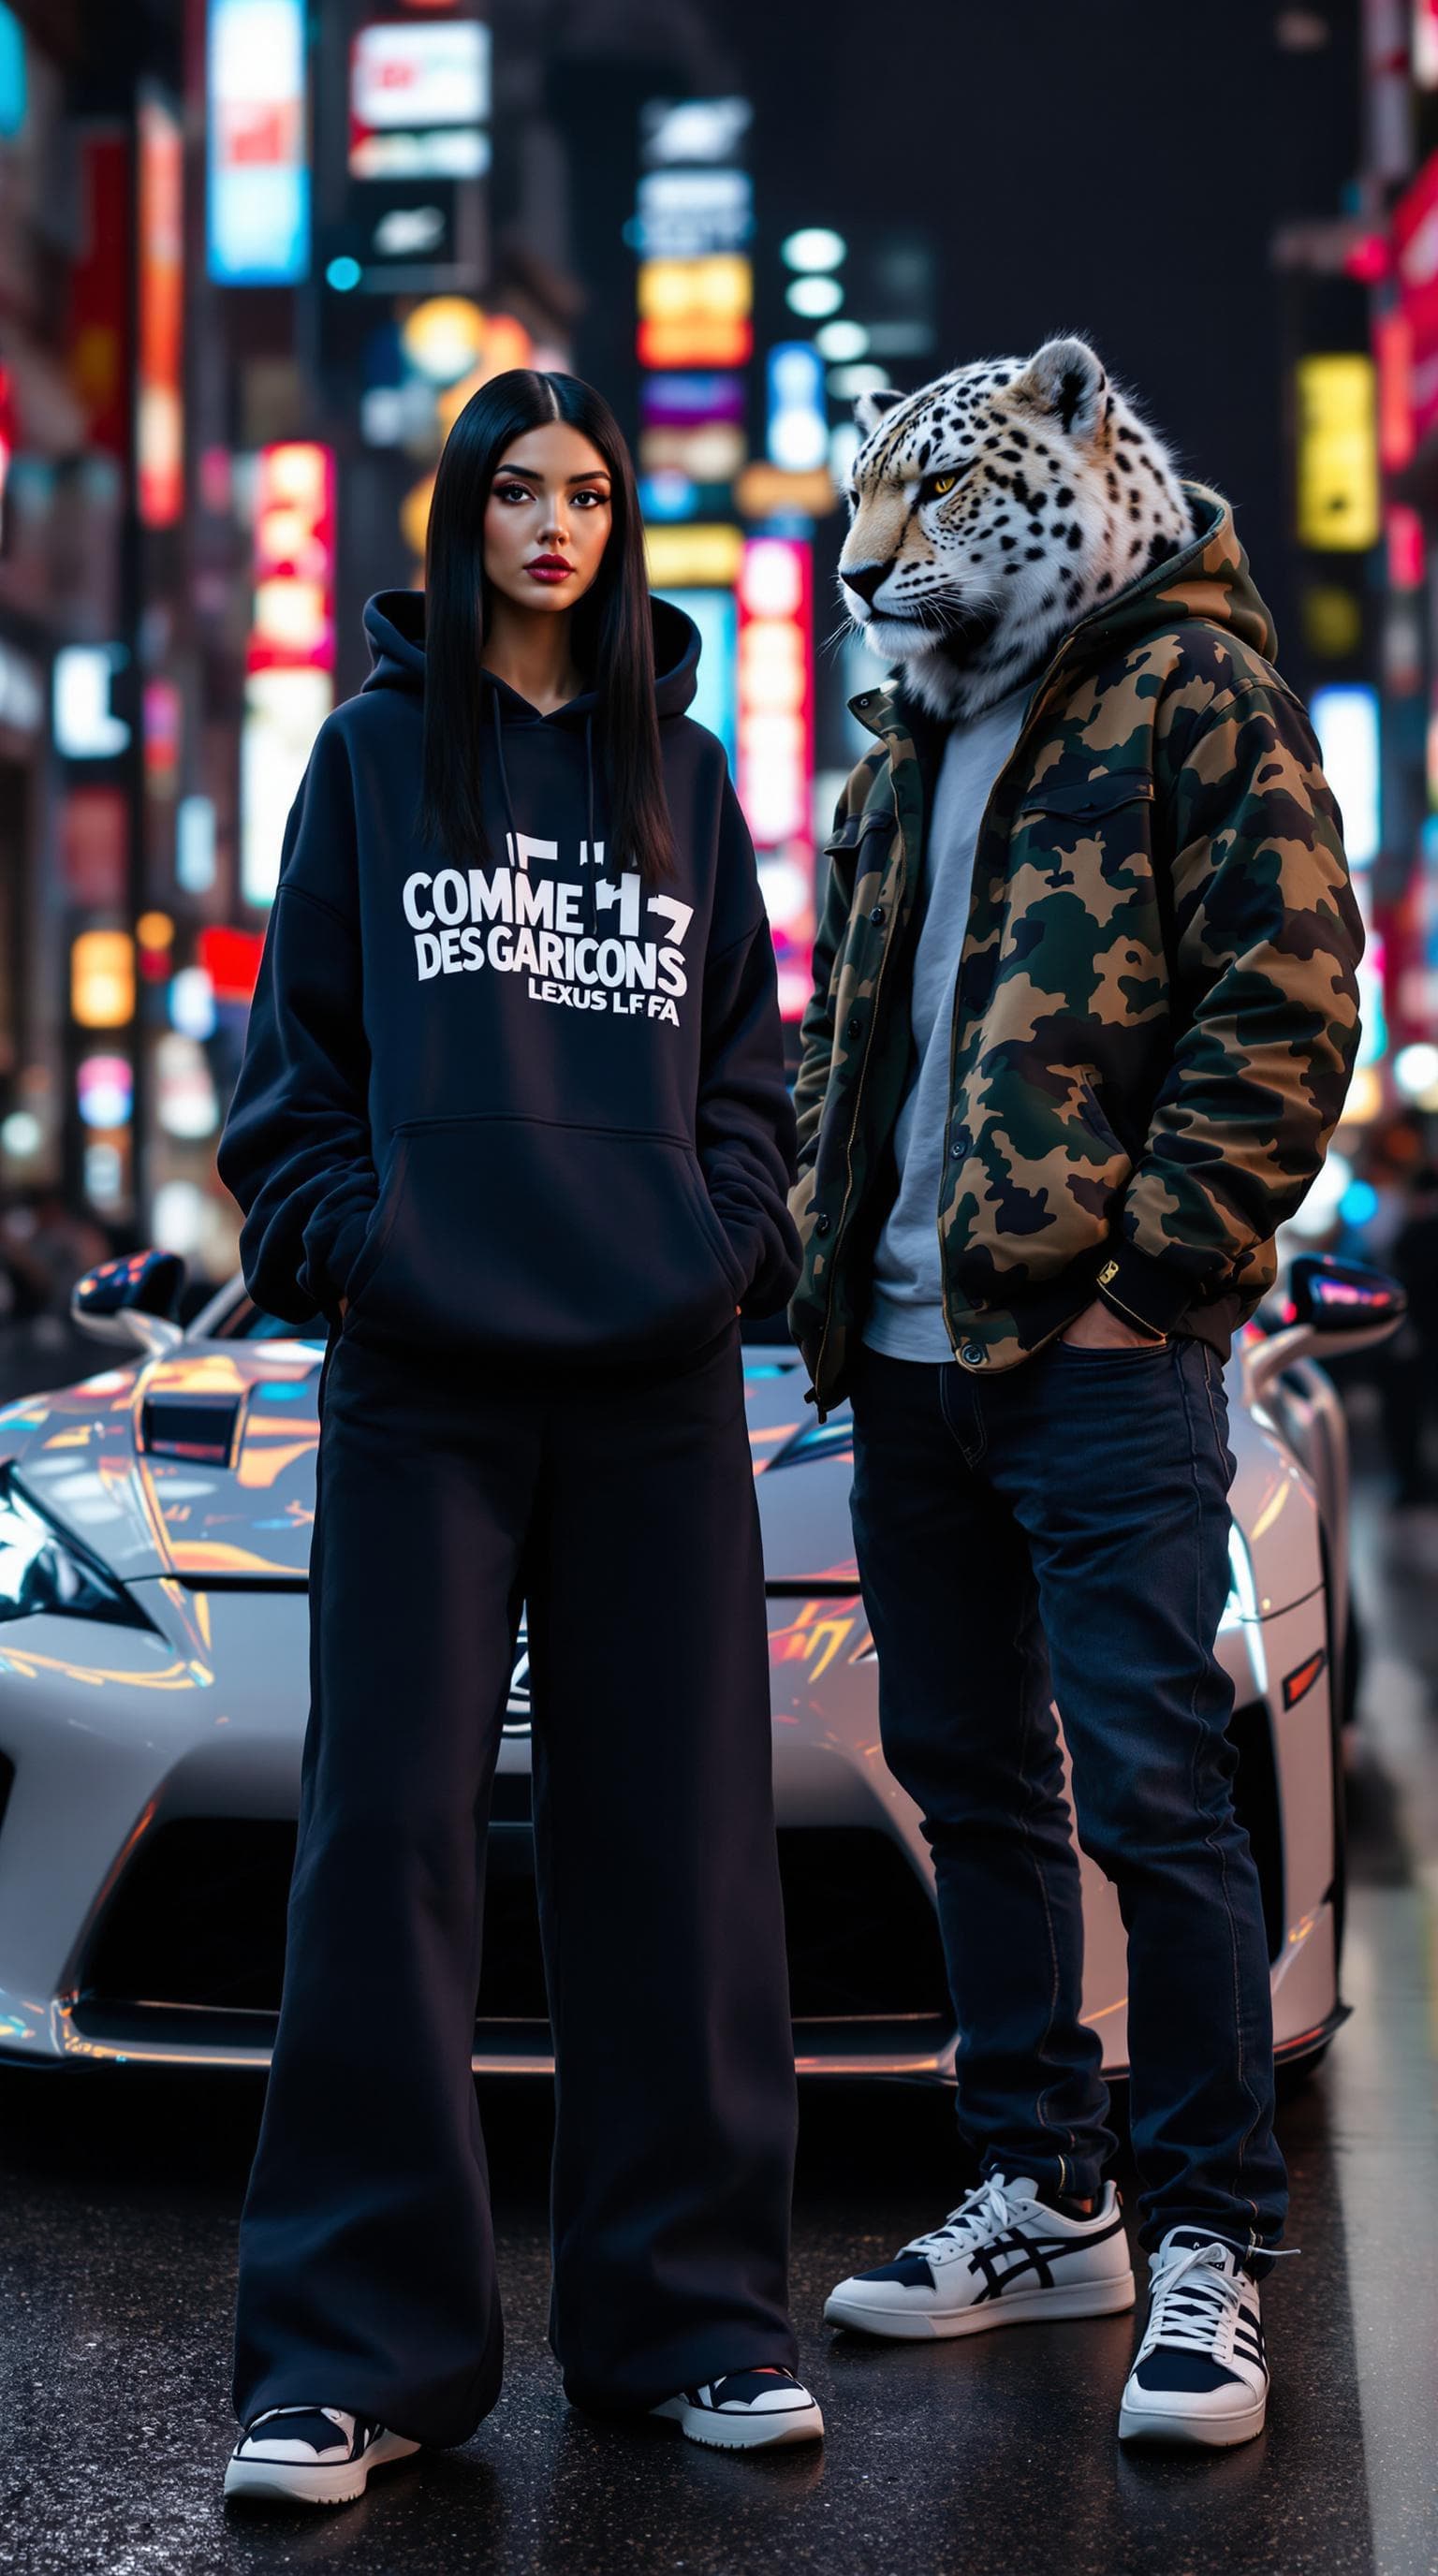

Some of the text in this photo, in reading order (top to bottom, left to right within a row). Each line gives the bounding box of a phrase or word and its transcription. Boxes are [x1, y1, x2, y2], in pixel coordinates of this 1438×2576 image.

[403, 867, 584, 935] COMME
[414, 925, 688, 998] DES GARICONS
[528, 977, 608, 1011] LEXUS
